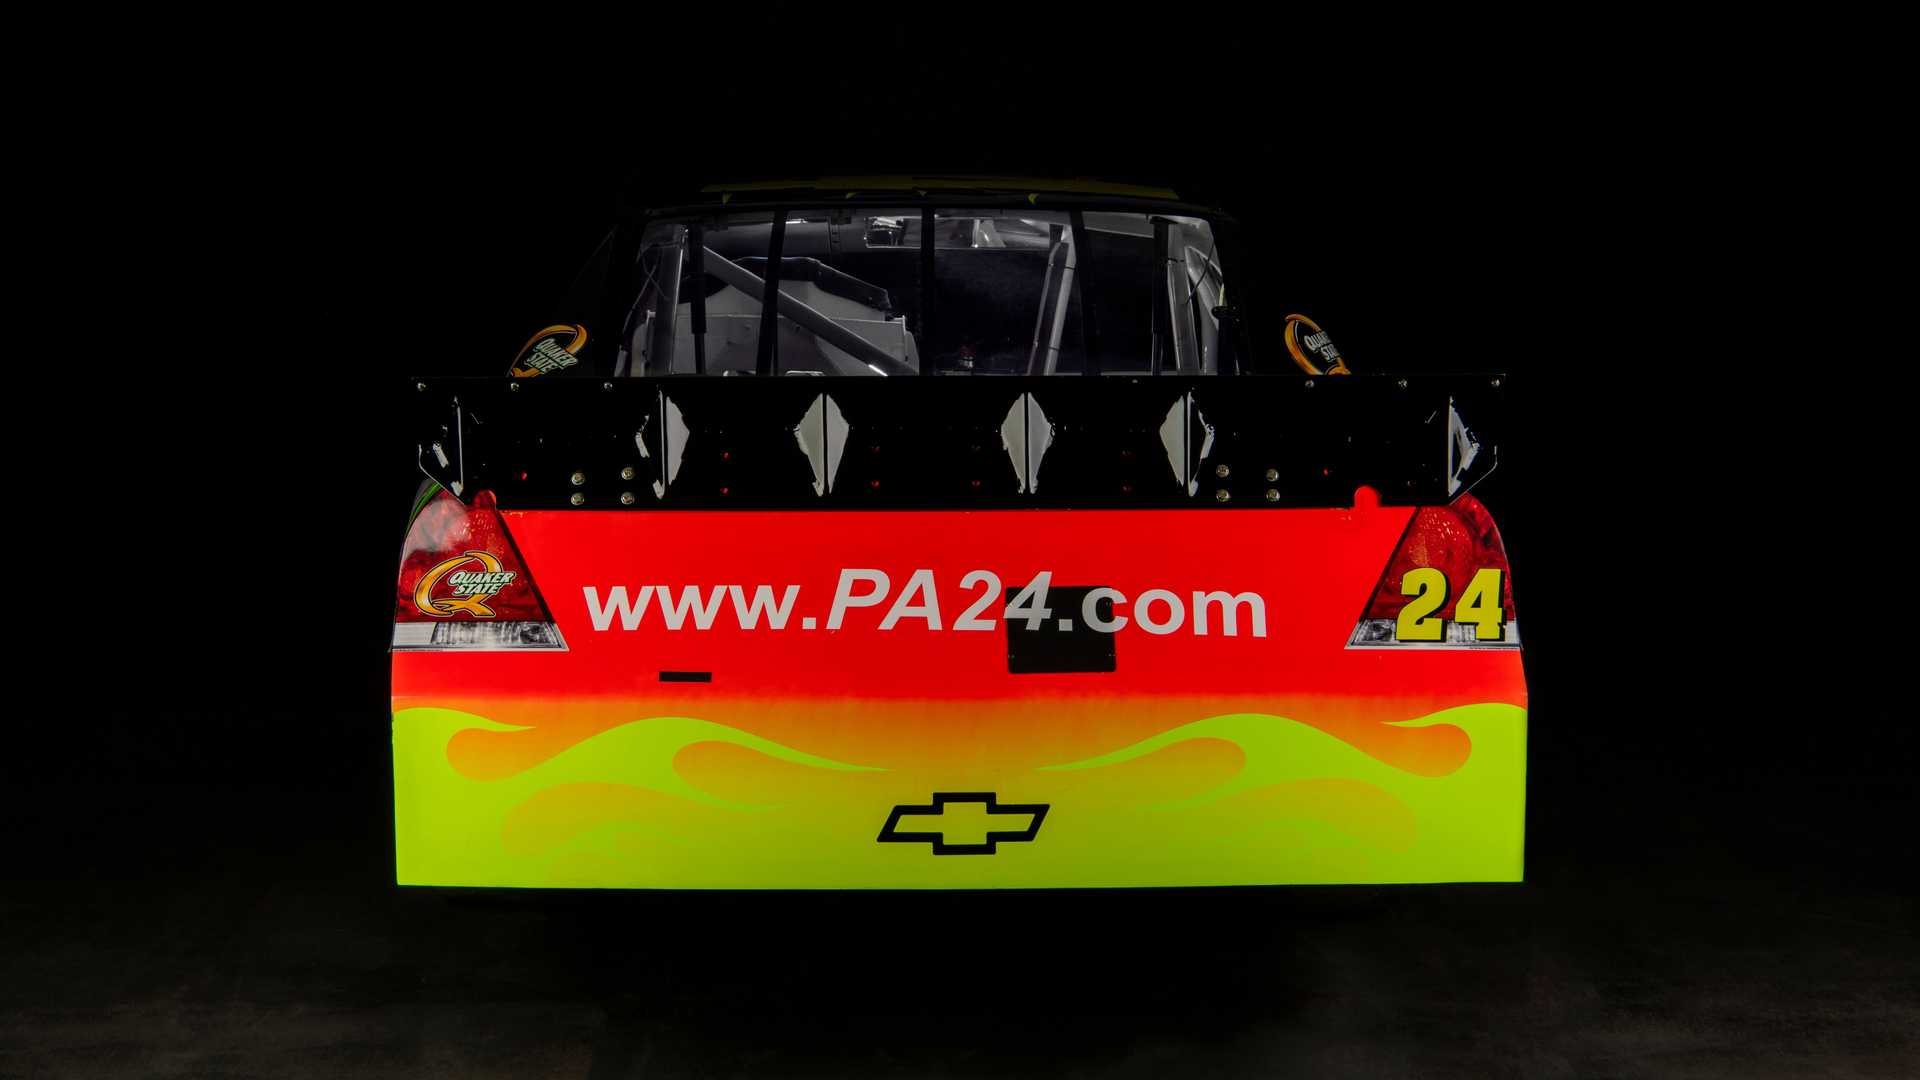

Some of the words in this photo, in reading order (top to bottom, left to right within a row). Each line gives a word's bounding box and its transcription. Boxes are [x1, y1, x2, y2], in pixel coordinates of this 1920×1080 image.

[525, 352, 562, 374] STATE
[534, 338, 578, 369] QUAKER
[449, 571, 514, 584] QUAKER
[454, 583, 500, 595] STATE
[582, 568, 1267, 638] www.PA24.com
[1395, 567, 1505, 642] 24
